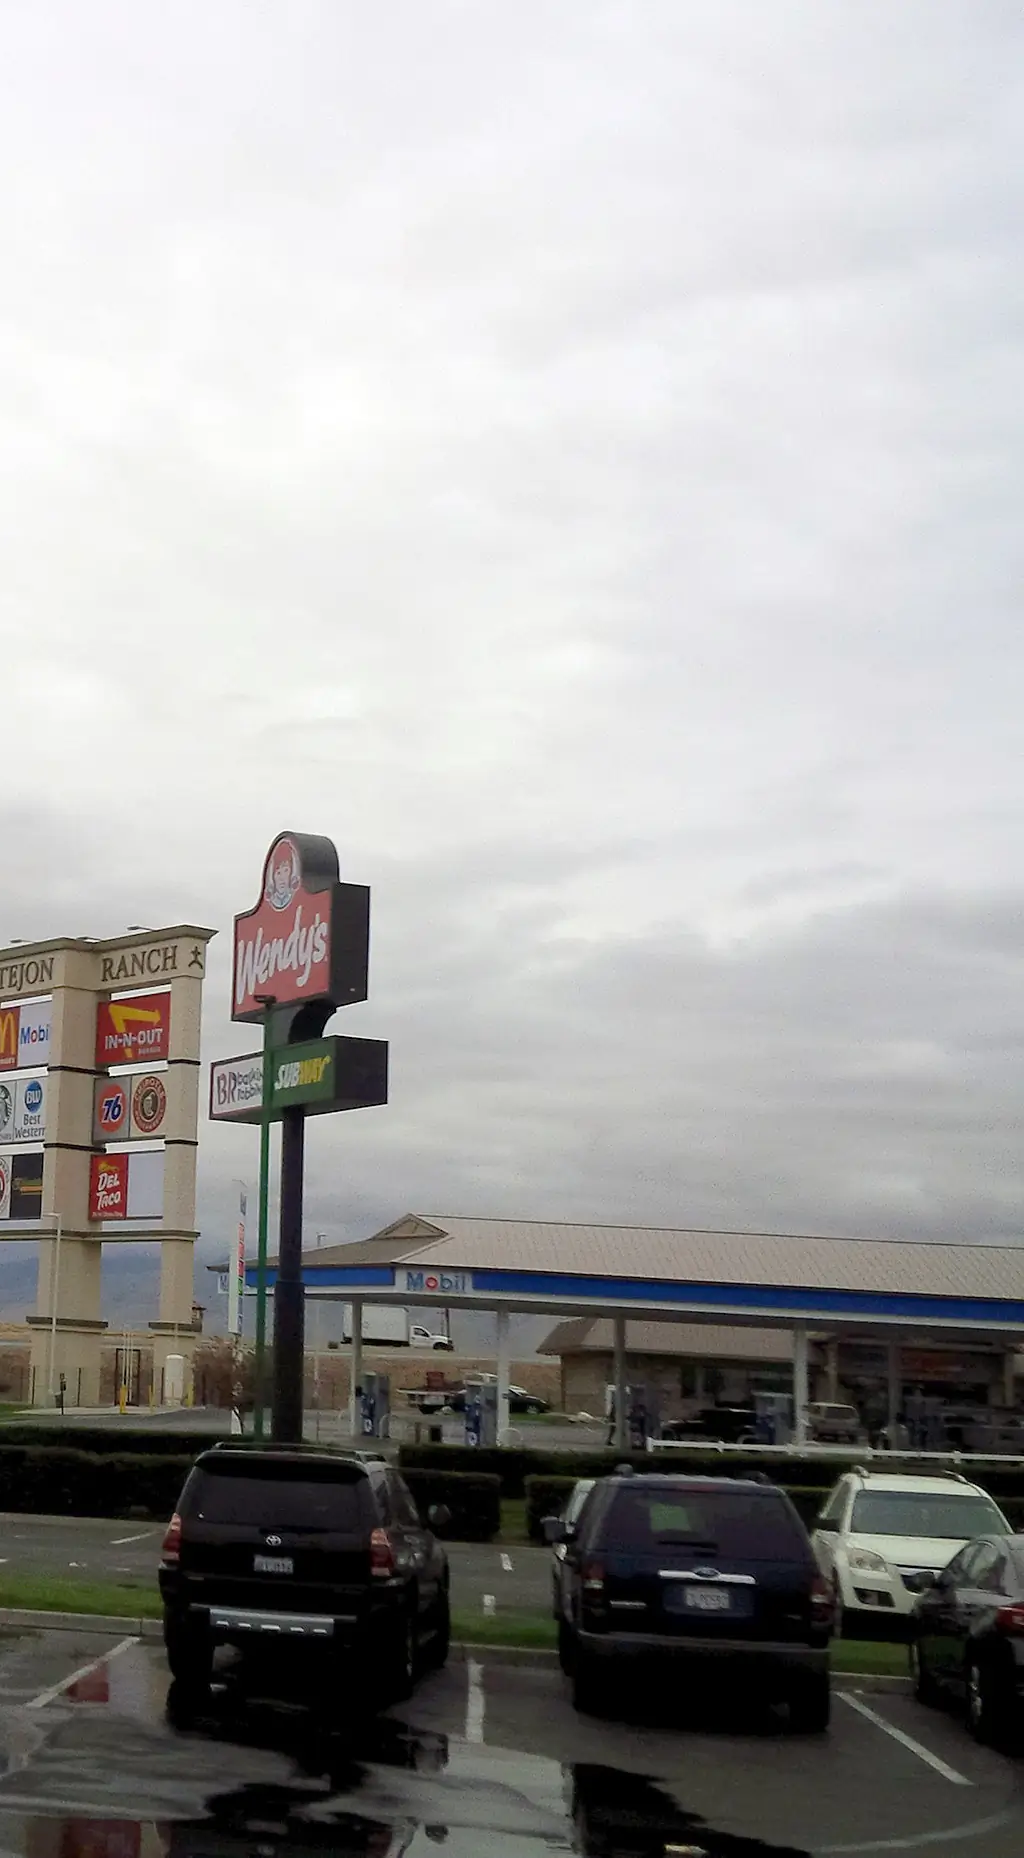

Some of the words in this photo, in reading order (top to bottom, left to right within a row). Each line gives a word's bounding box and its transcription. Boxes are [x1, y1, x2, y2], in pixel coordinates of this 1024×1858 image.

[101, 945, 178, 982] RANCH
[236, 905, 328, 1004] Wendy's
[20, 1024, 49, 1045] Mobi
[104, 1027, 164, 1050] IN-N-OUT
[275, 1055, 331, 1091] SUBWAY
[217, 1072, 237, 1105] BR
[24, 1113, 41, 1126] Best
[102, 1093, 123, 1124] 76
[14, 1126, 46, 1139] Western
[98, 1172, 120, 1191] DEL
[407, 1271, 466, 1292] Mobil
